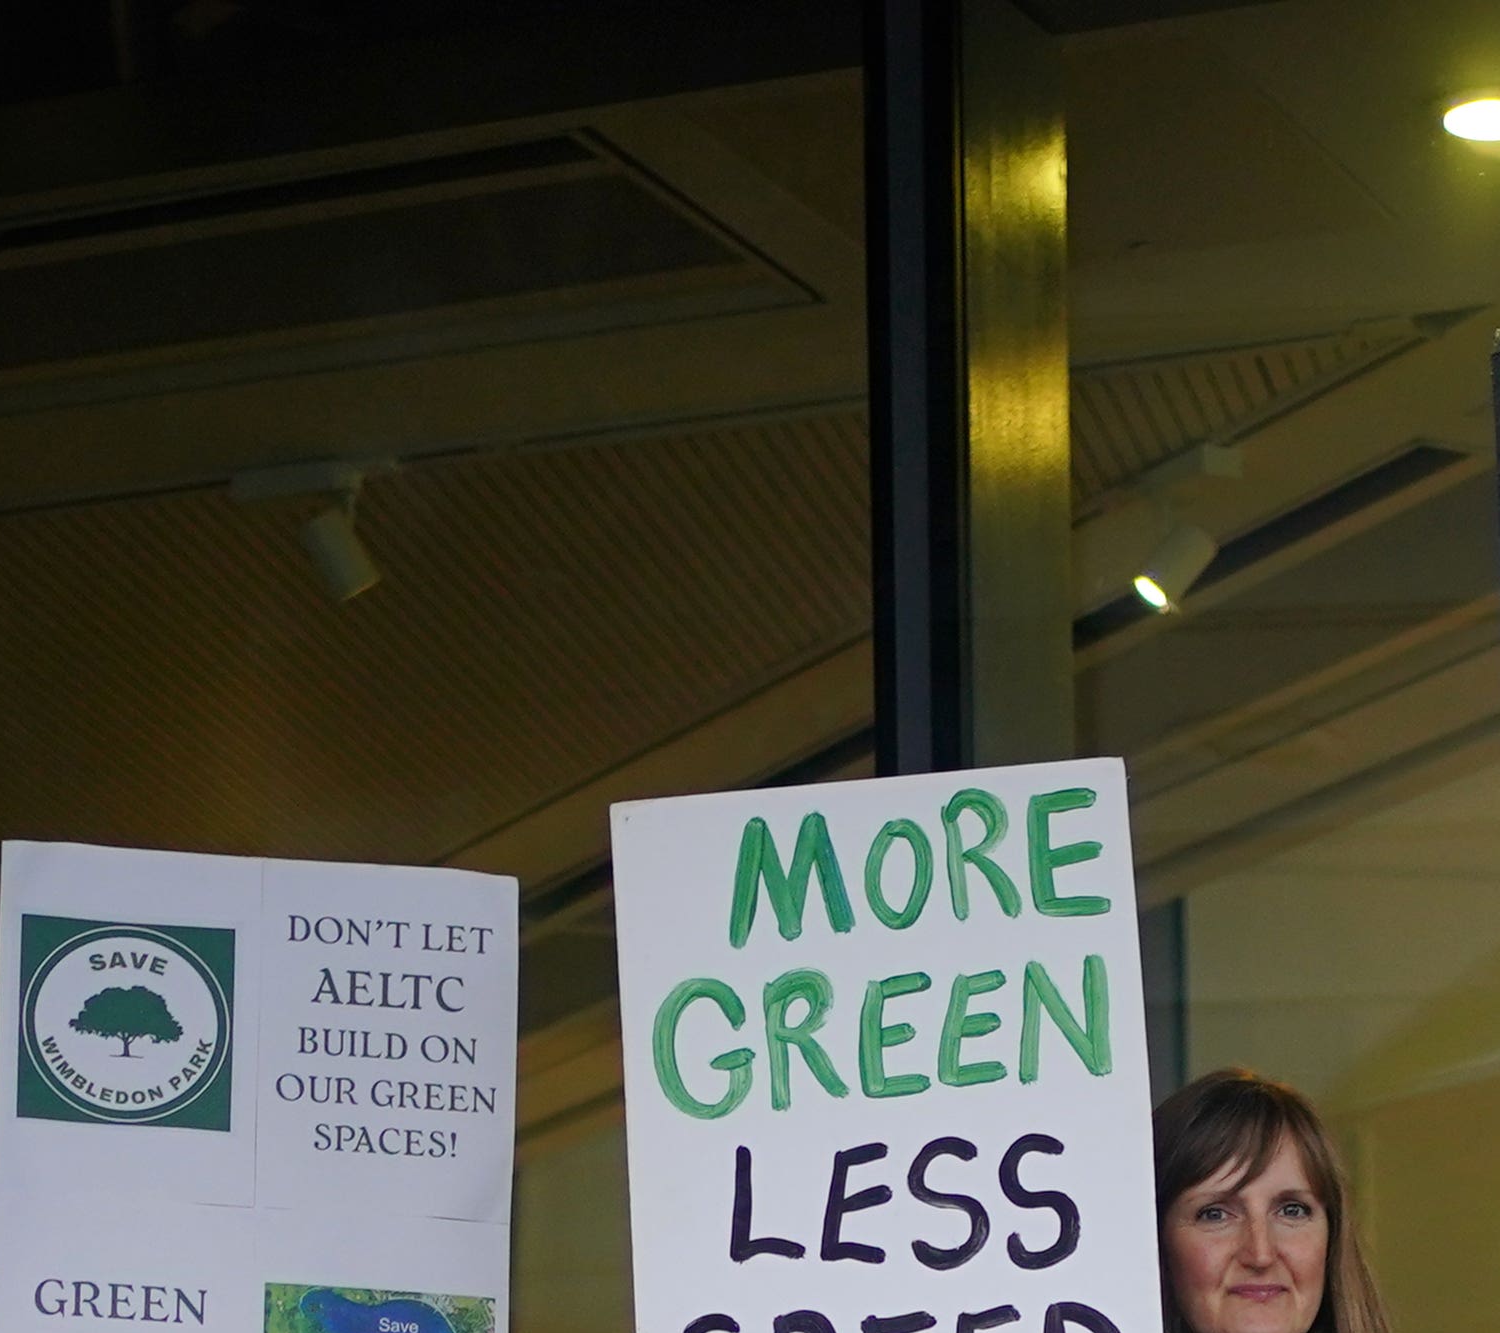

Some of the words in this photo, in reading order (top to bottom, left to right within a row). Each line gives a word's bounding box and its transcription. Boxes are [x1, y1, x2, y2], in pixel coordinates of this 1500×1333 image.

[728, 787, 1112, 949] MORE
[287, 915, 410, 949] DON'T
[422, 923, 494, 955] LET
[88, 951, 169, 976] SAVE
[310, 967, 466, 1013] AELTC
[298, 1026, 408, 1060] BUILD
[420, 1034, 478, 1065] ON
[652, 954, 1114, 1120] GREEN
[41, 1036, 164, 1104] WIMBLEDON
[168, 1038, 214, 1092] PARK
[275, 1073, 358, 1105] OUR
[370, 1079, 497, 1114] GREEN
[313, 1123, 457, 1158] SPACES!
[730, 1133, 1082, 1271] LESS
[34, 1278, 208, 1325] GREEN
